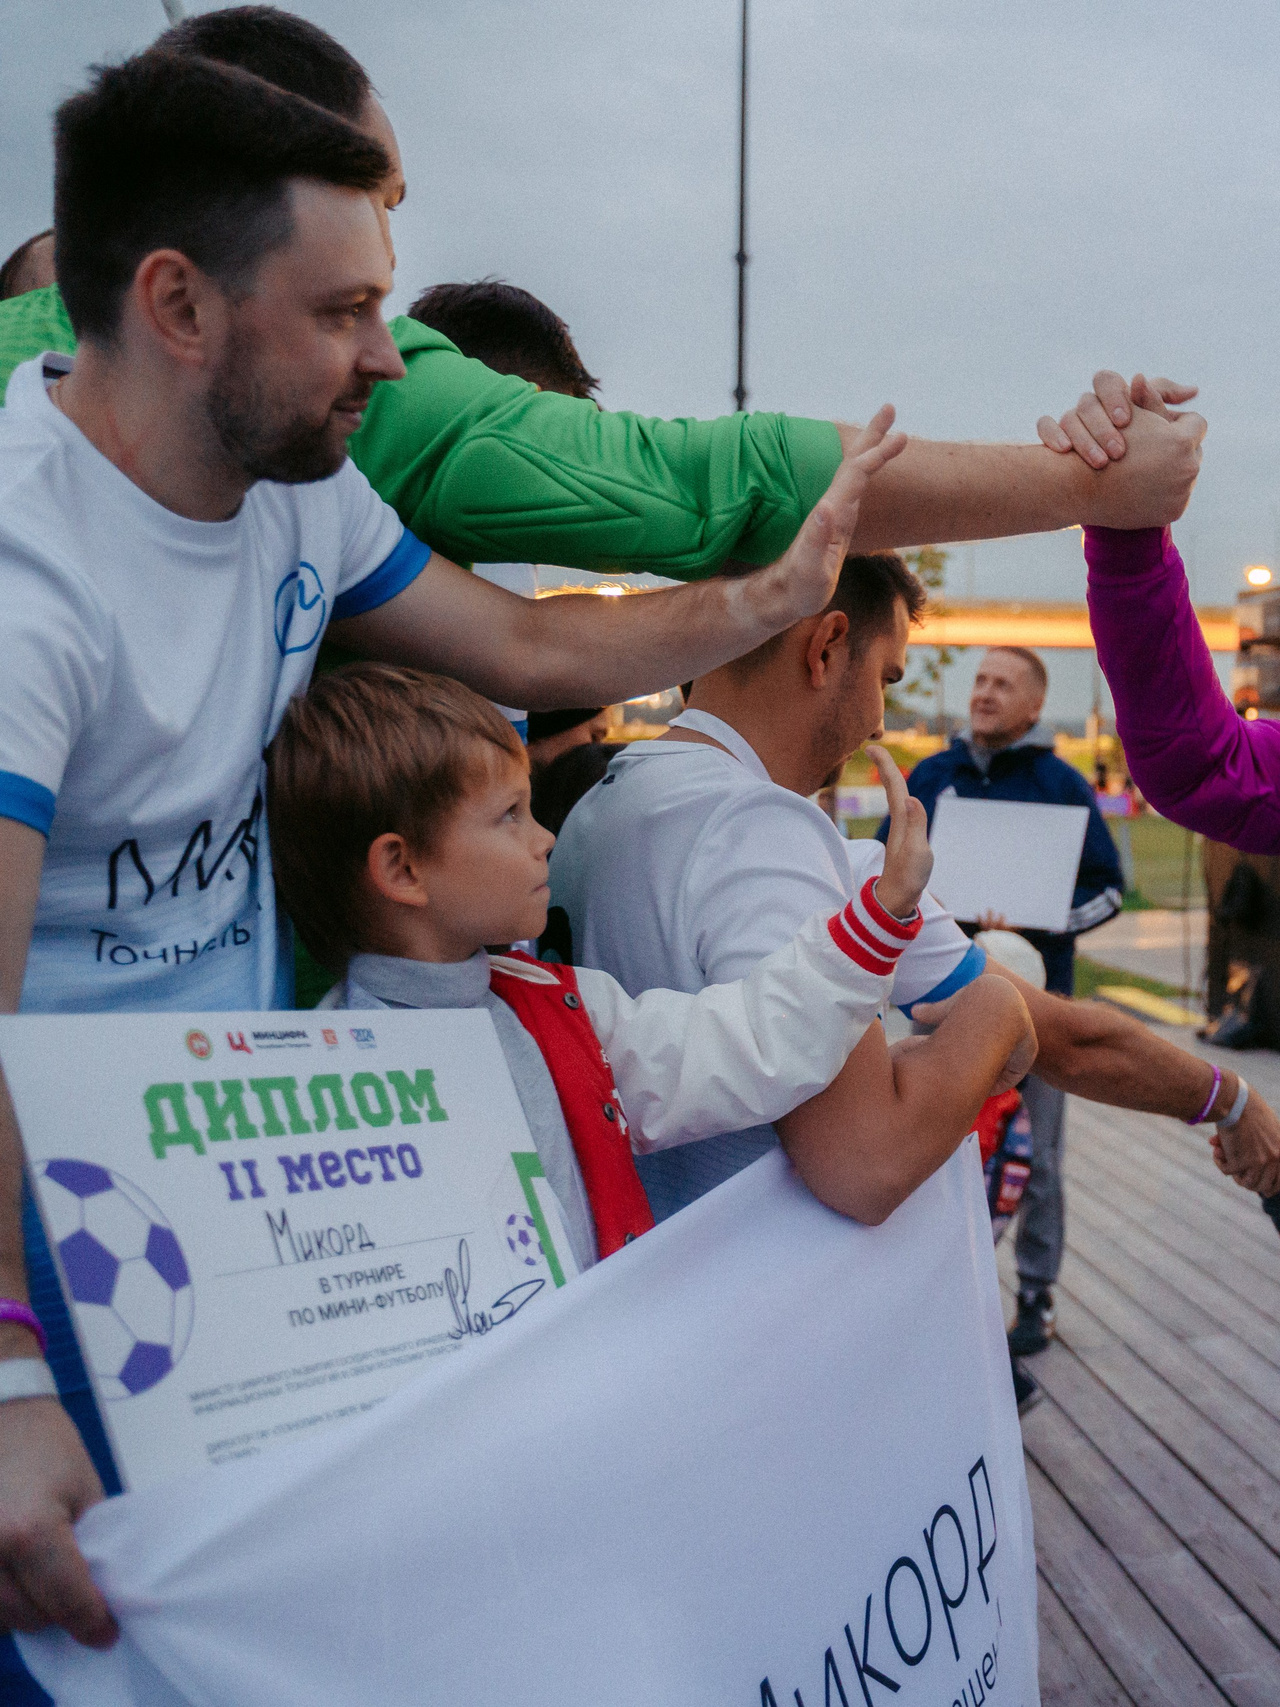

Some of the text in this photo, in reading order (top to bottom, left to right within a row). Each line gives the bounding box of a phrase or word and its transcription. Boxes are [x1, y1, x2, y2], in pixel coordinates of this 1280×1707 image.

[143, 1068, 450, 1160] ДИПЛОМ
[318, 1263, 406, 1294] В ТУРНИРЕ
[288, 1281, 446, 1328] ПО МИНИ-ФУТБОЛУ
